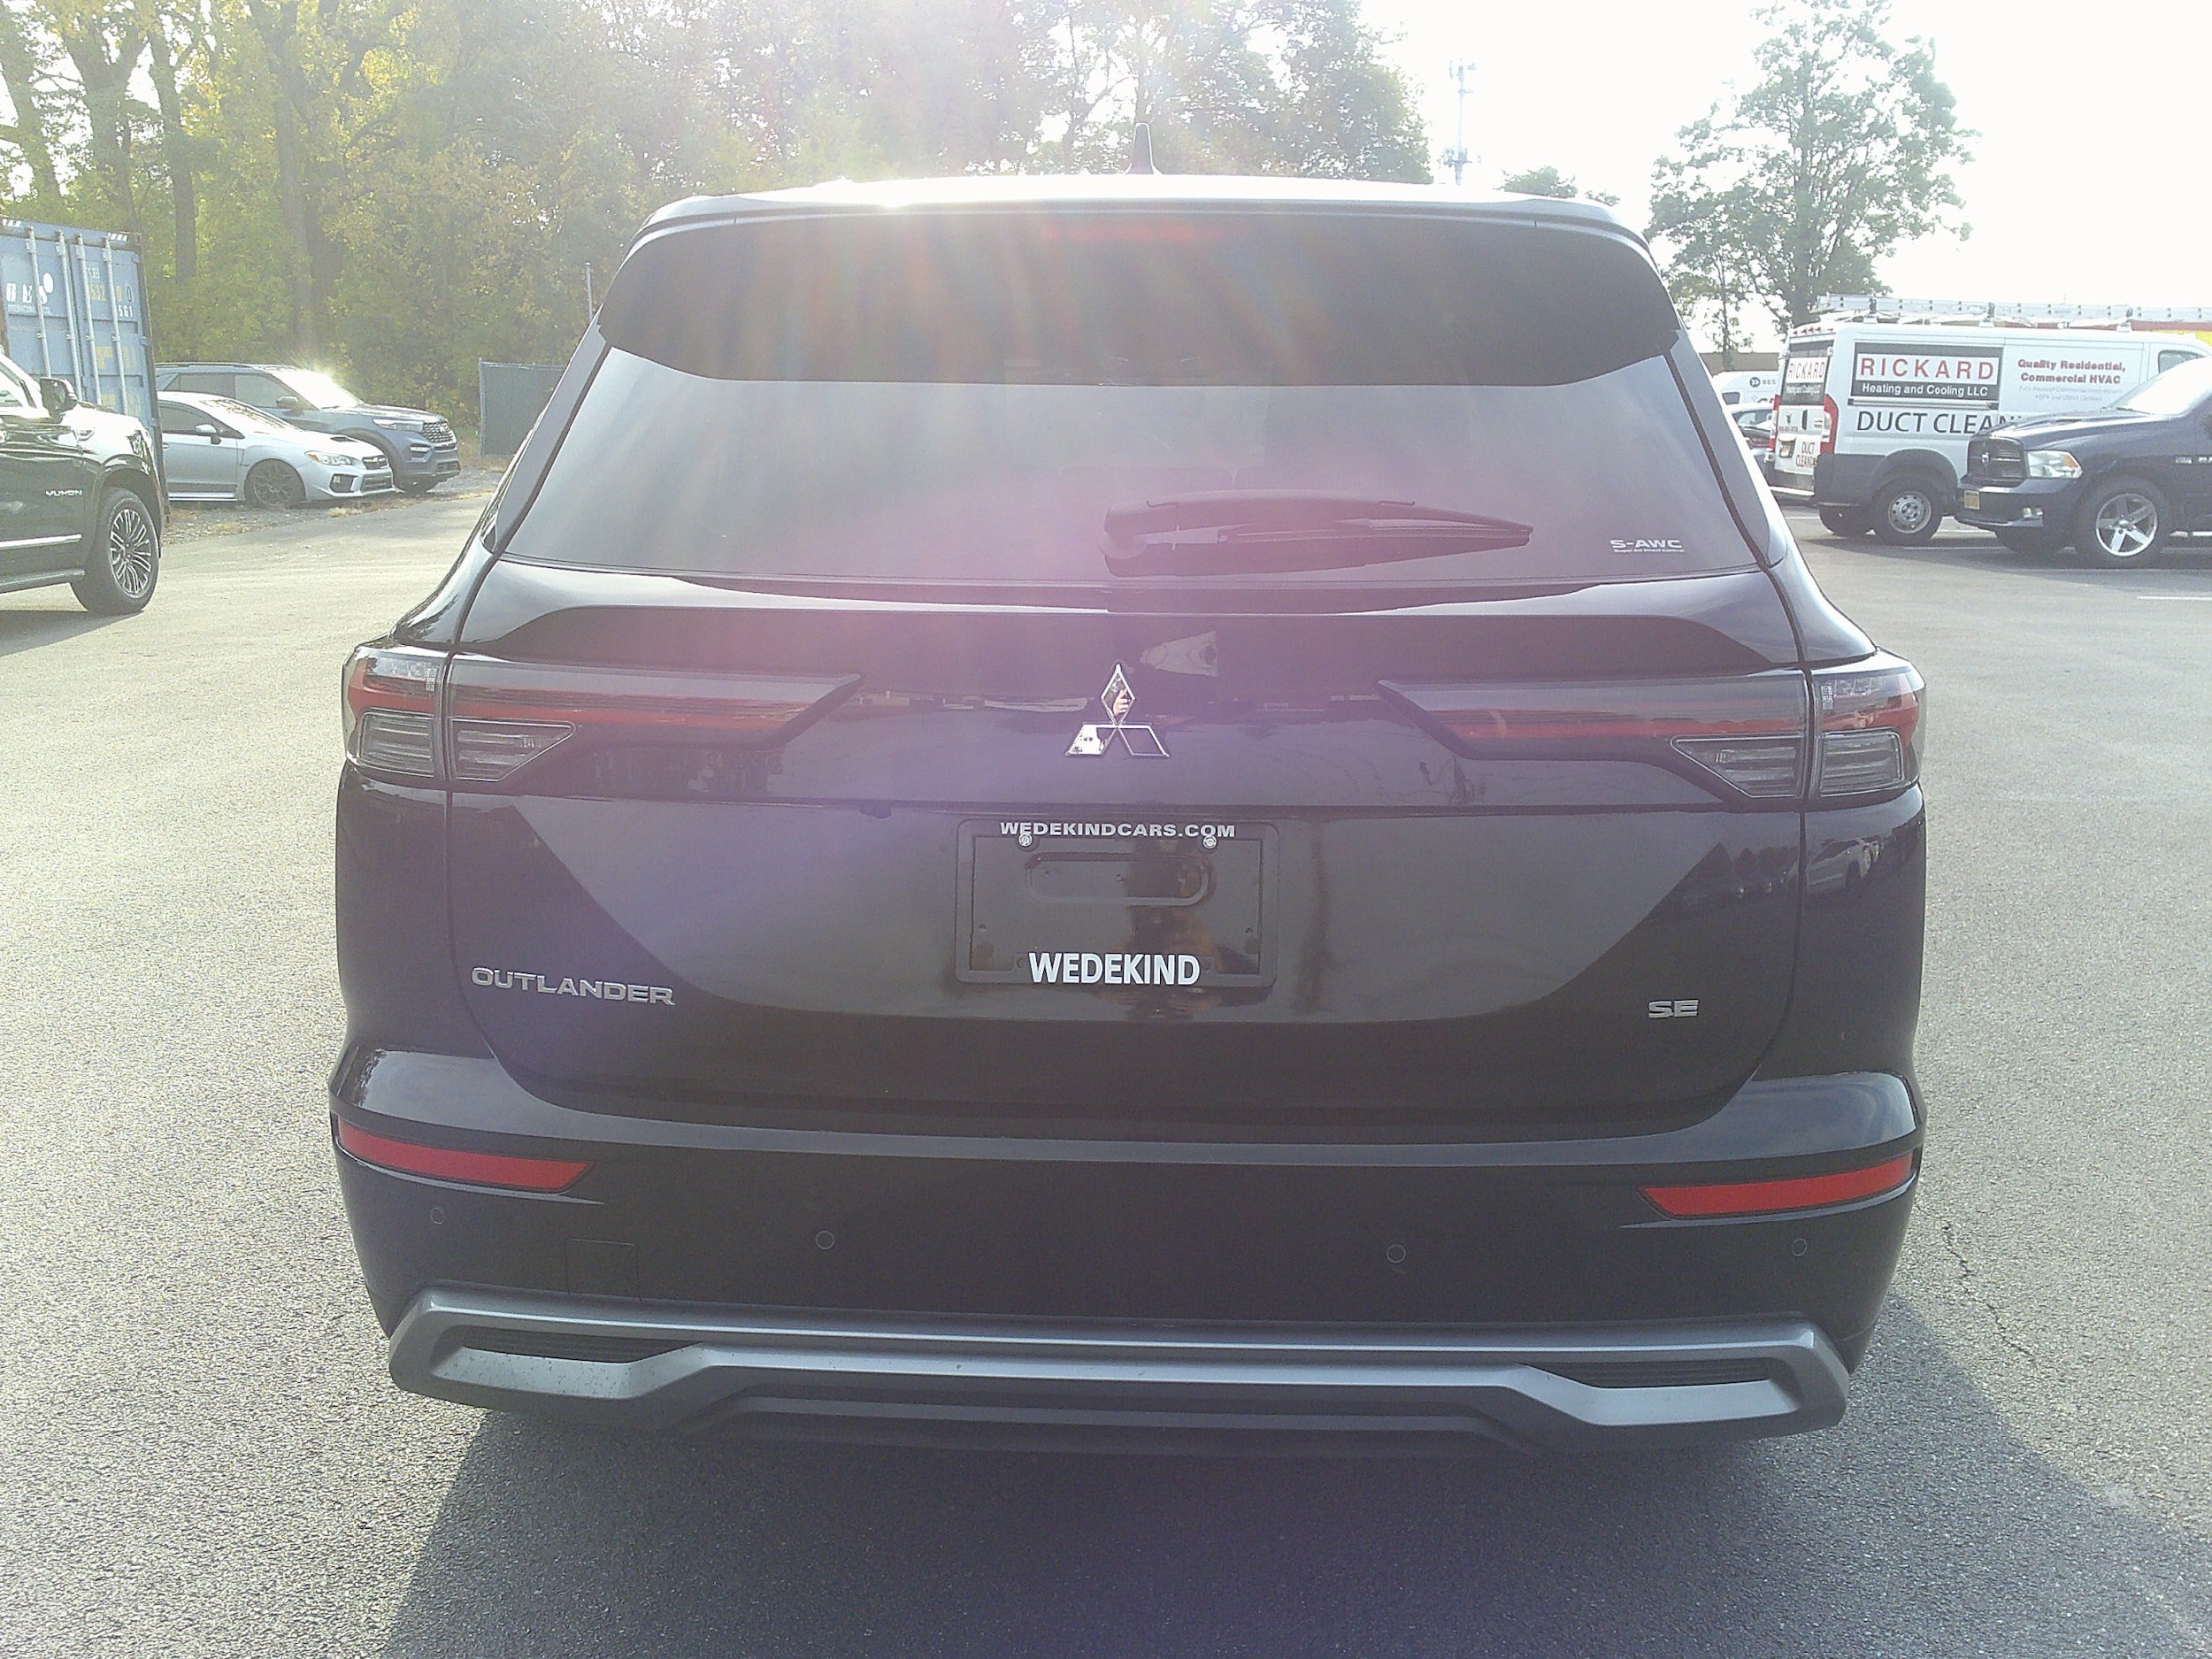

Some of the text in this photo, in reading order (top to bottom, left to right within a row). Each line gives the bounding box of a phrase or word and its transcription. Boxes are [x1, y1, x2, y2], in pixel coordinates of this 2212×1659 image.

[1788, 361, 1825, 379] RICKARD
[1860, 357, 1994, 380] RICKARD
[2017, 358, 2126, 373] Quality Residential,
[2020, 372, 2122, 384] Commercial HVAC
[1862, 383, 1989, 396] Heating and Cooling LLC
[1857, 411, 1928, 433] DUCT
[1610, 539, 1683, 549] S-AWC
[1000, 822, 1235, 838] WEDEKINDCARS.COM
[1029, 952, 1201, 986] WEDEKIND
[471, 967, 676, 1006] OUTLANDER
[1648, 999, 1700, 1018] SE
